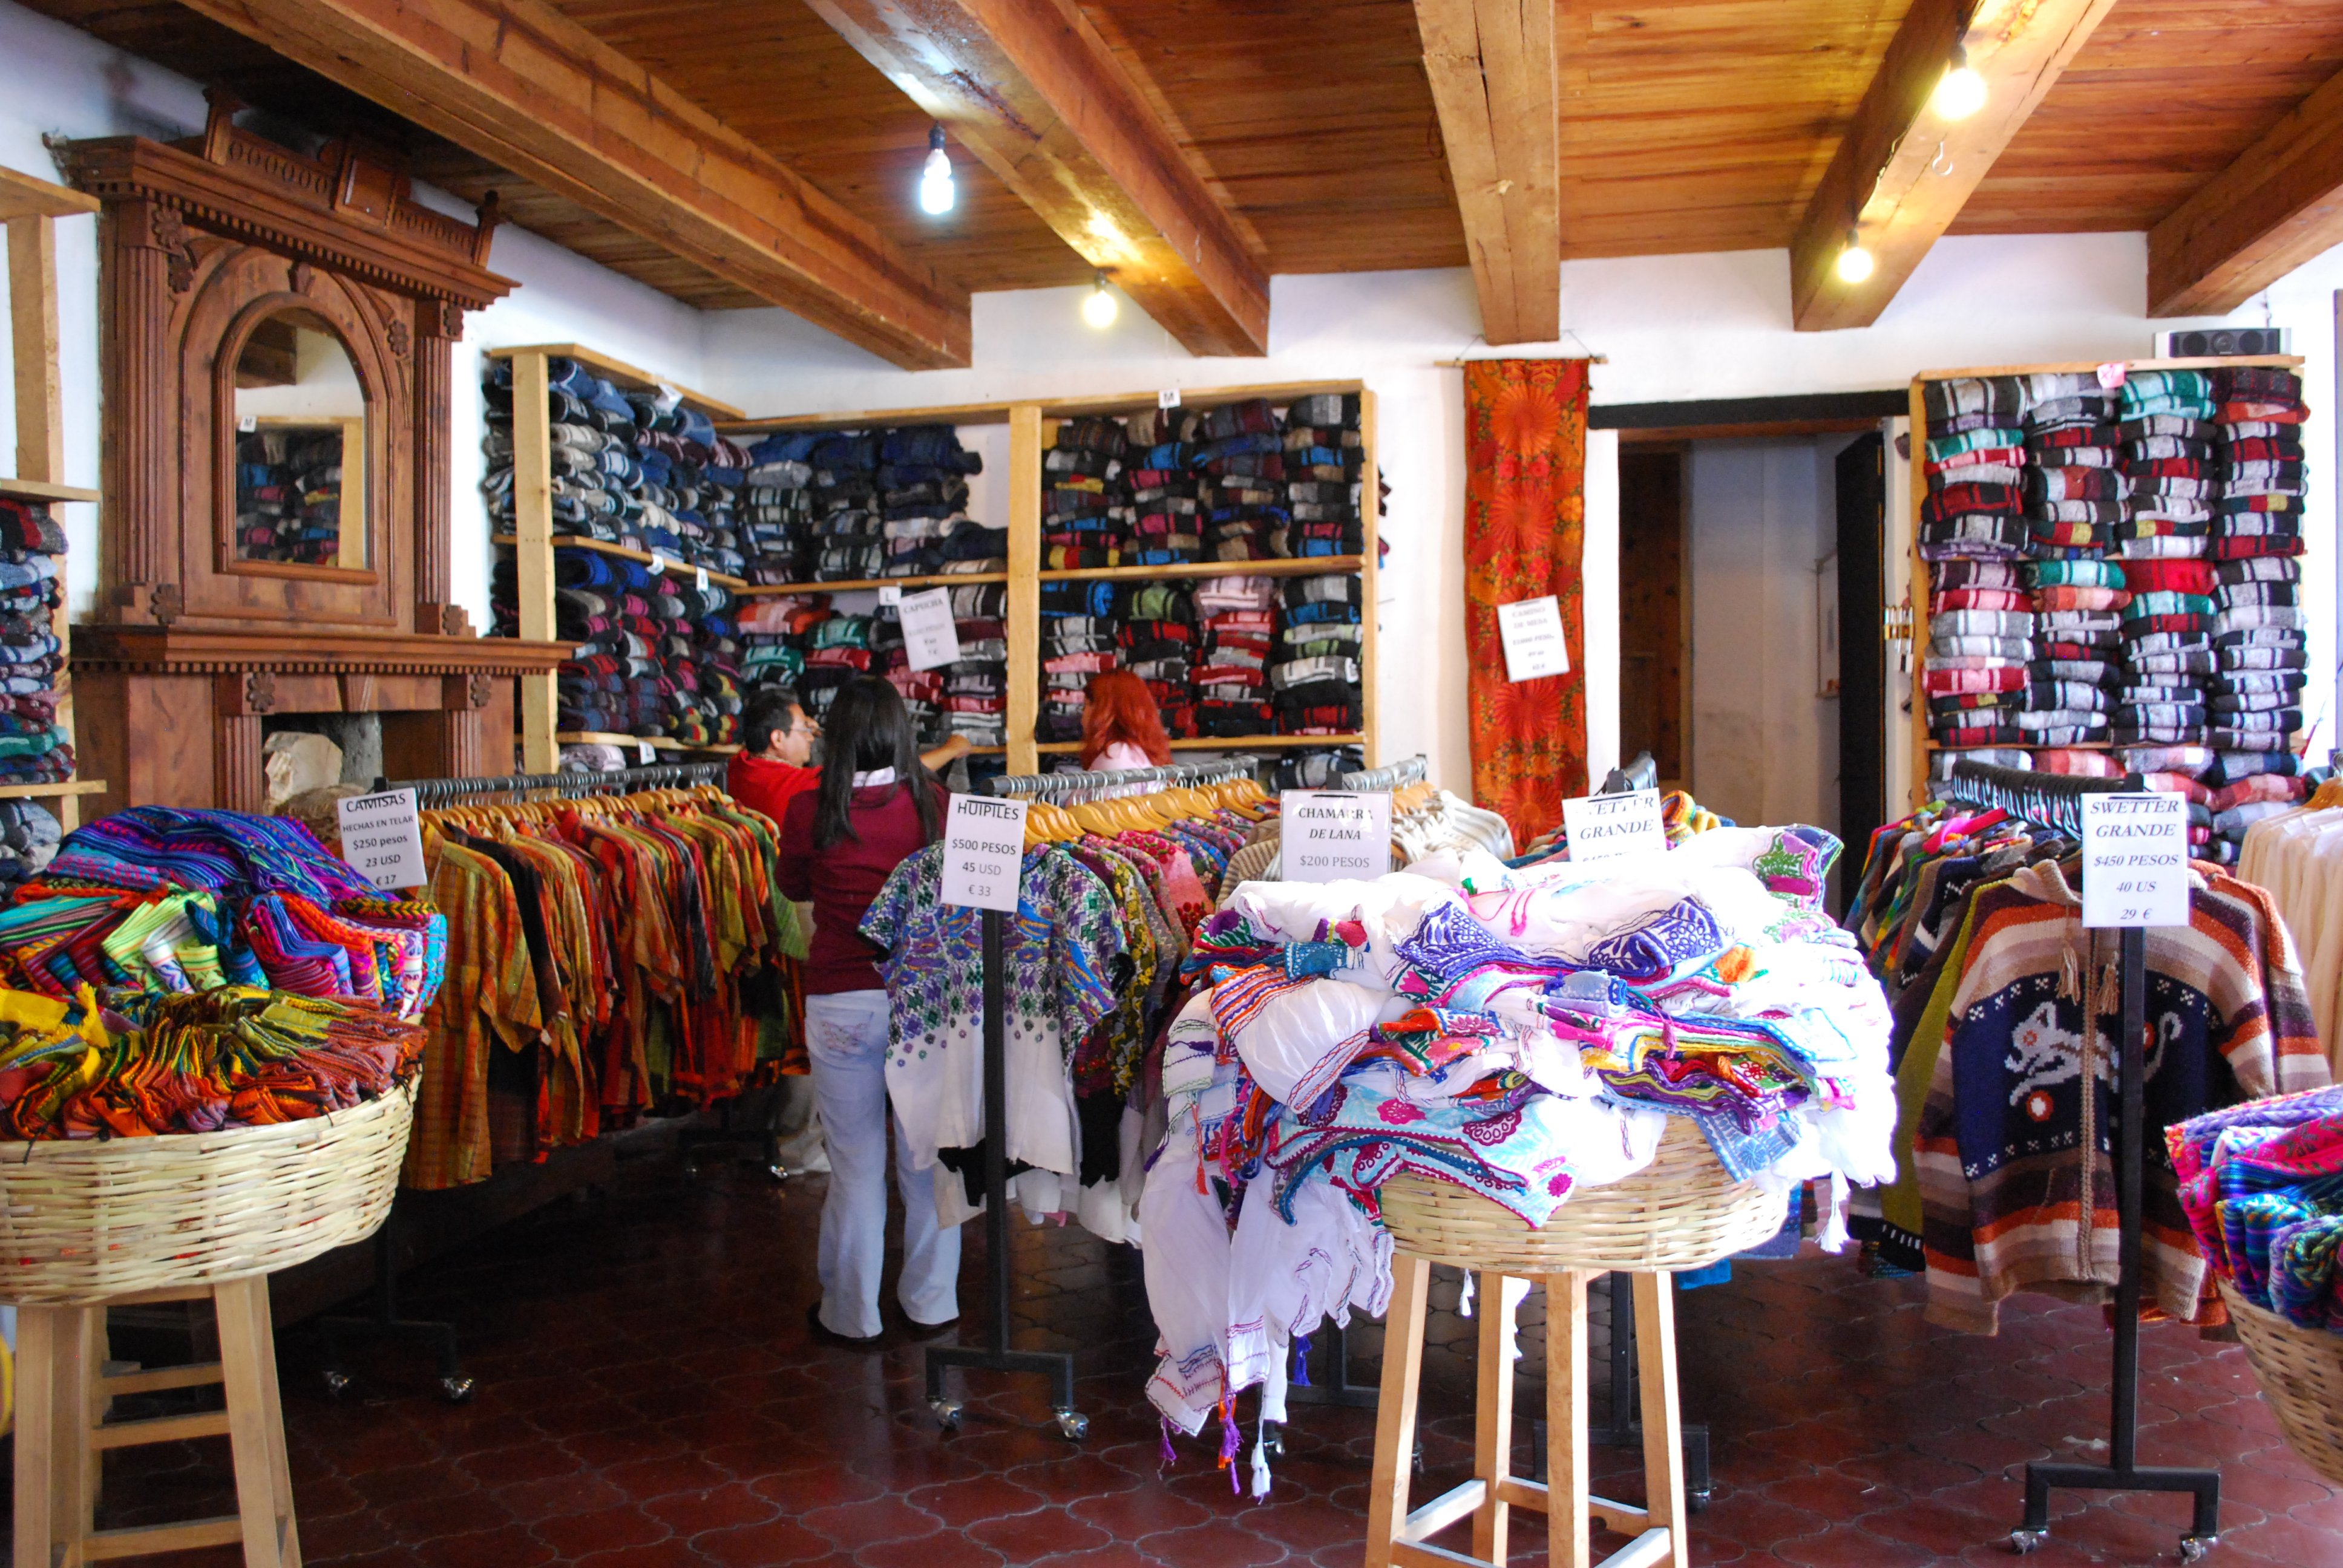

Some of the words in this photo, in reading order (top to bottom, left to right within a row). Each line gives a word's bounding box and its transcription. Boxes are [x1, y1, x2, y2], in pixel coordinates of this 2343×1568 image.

[1164, 391, 1174, 402] M
[885, 592, 893, 602] L
[903, 598, 943, 614] CAPUCHA
[346, 793, 406, 812] CAMISAS
[2090, 800, 2179, 814] SWETTER
[957, 802, 1019, 820] HUIPILES
[342, 821, 374, 832] HECHAS
[376, 820, 387, 828] EN
[390, 815, 413, 826] TELAR
[1580, 819, 1654, 840] GRANDE
[1309, 829, 1326, 839] DE
[1328, 829, 1361, 840] LANA
[2096, 823, 2176, 838] GRANDE
[353, 838, 377, 851] $250
[380, 835, 407, 848] pesos
[952, 838, 978, 851] $500
[981, 841, 1016, 855] PESOS
[365, 857, 377, 867] 23
[381, 854, 401, 865] USD
[1300, 855, 1329, 867] $200
[1332, 857, 1370, 868] PESOS
[2094, 855, 2124, 867] $450
[2128, 854, 2178, 866] PESOS
[962, 862, 975, 872] 45
[979, 863, 1001, 875] USD
[376, 877, 382, 886] €
[384, 874, 396, 885] 17
[2116, 881, 2131, 892] 40
[2136, 881, 2156, 892] US
[969, 884, 975, 894] €
[978, 886, 991, 897] 33
[2120, 909, 2136, 920] 29
[2143, 908, 2152, 920] €
